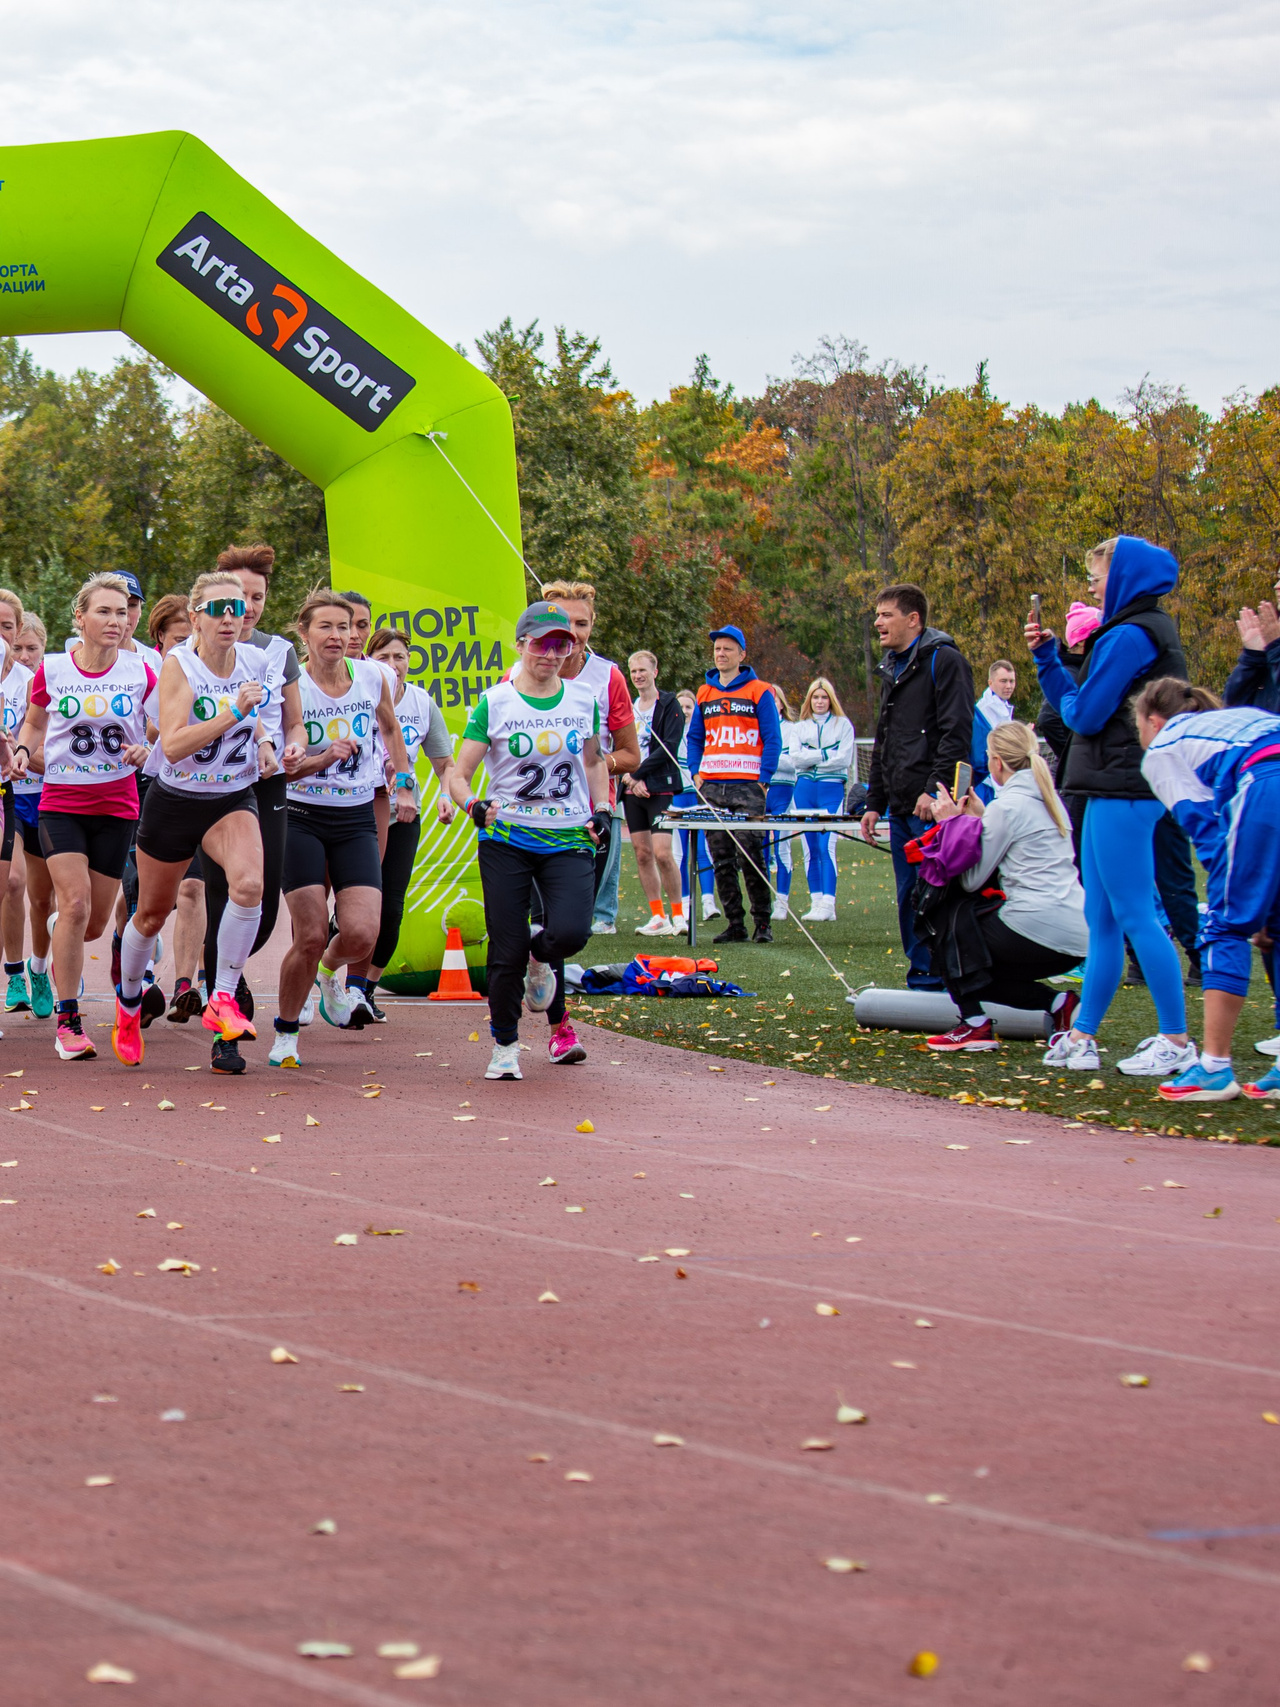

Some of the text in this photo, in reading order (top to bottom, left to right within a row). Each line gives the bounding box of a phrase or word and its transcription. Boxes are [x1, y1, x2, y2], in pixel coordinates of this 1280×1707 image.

[173, 235, 393, 414] Arta Sport
[407, 640, 503, 675] ОРМА
[57, 684, 134, 695] VMARAFONE
[406, 676, 503, 708] ИЗН
[505, 717, 584, 731] VMARAFONE
[704, 702, 754, 715] Arta Sport
[69, 722, 125, 758] 86
[704, 726, 759, 748] СУДЬЯ
[514, 761, 574, 802] 23
